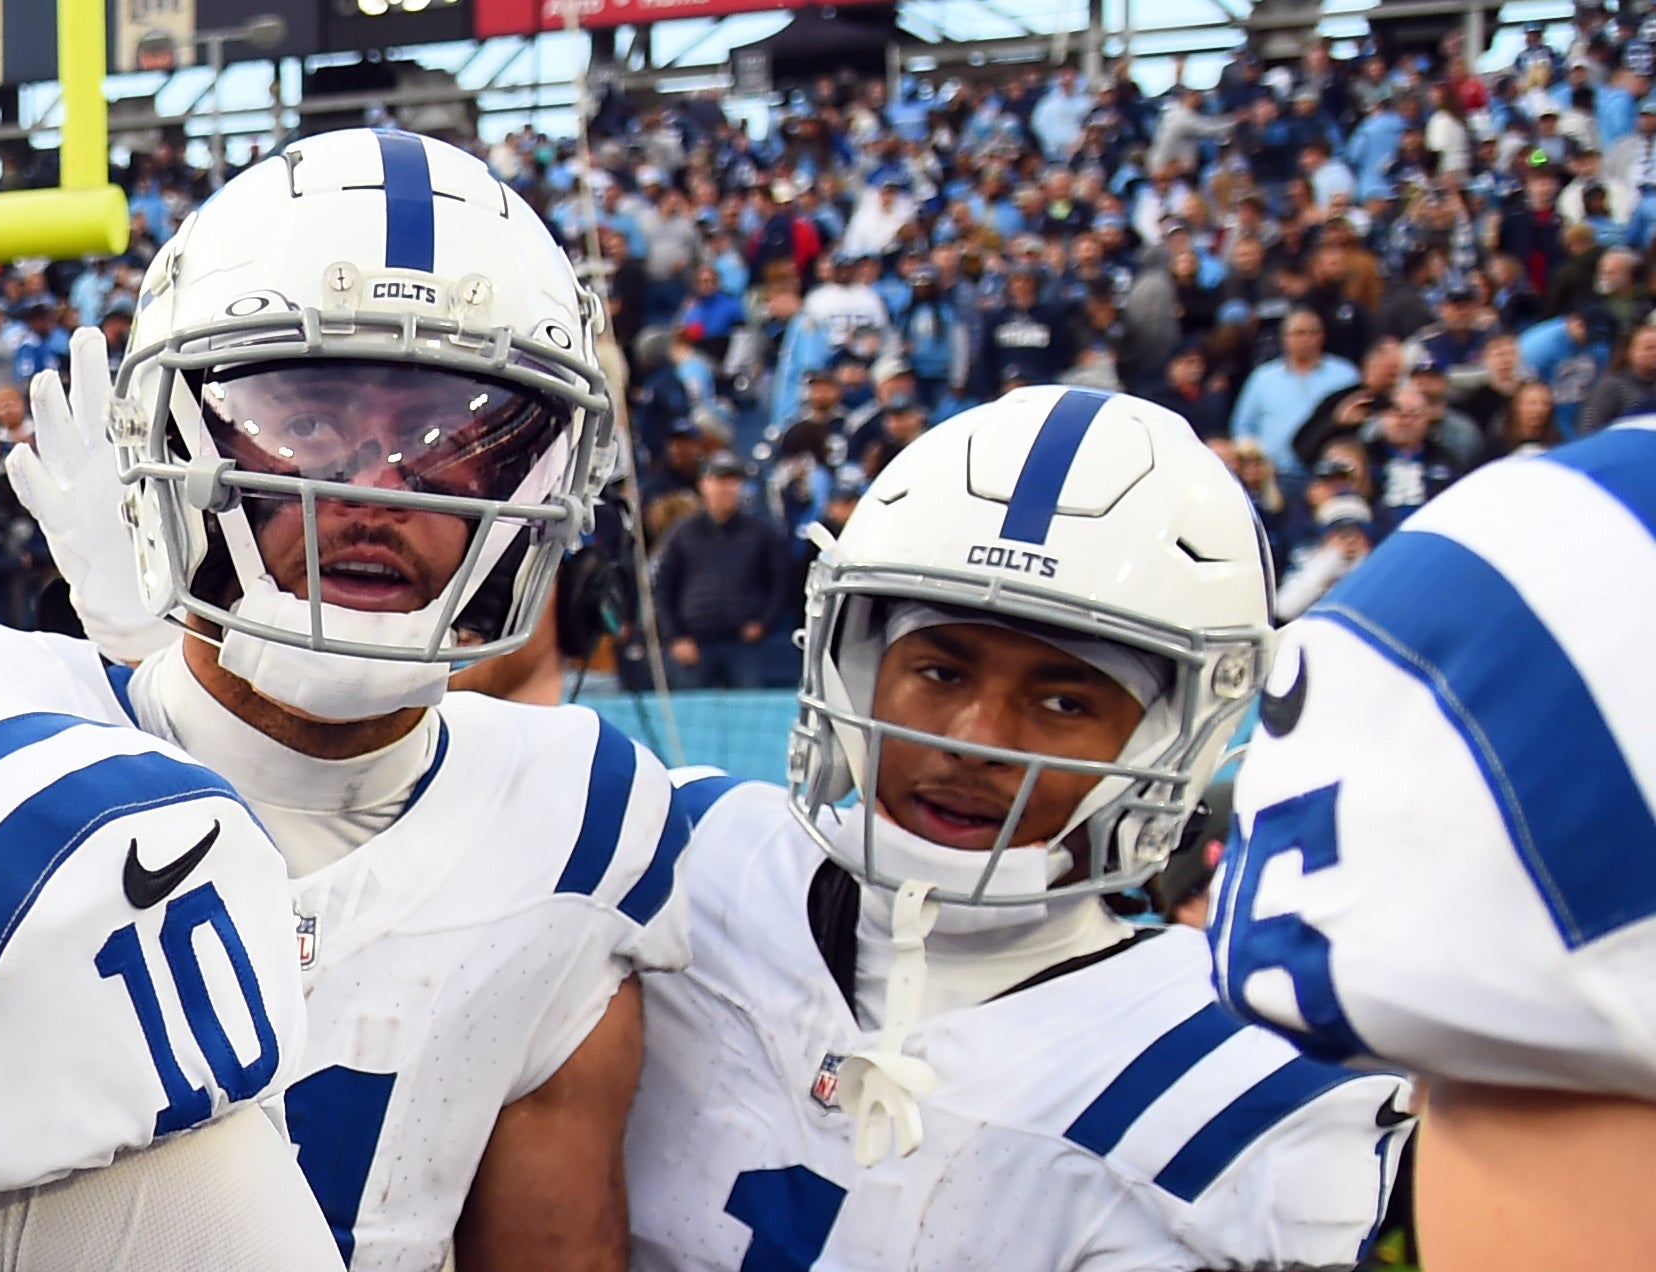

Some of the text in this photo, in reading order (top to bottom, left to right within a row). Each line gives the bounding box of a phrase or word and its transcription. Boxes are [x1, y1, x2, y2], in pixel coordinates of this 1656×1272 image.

[373, 282, 436, 304] COLTS
[967, 545, 1059, 578] COLTS
[1207, 780, 1369, 1063] 6
[94, 881, 280, 1136] 10
[816, 1074, 839, 1101] NF
